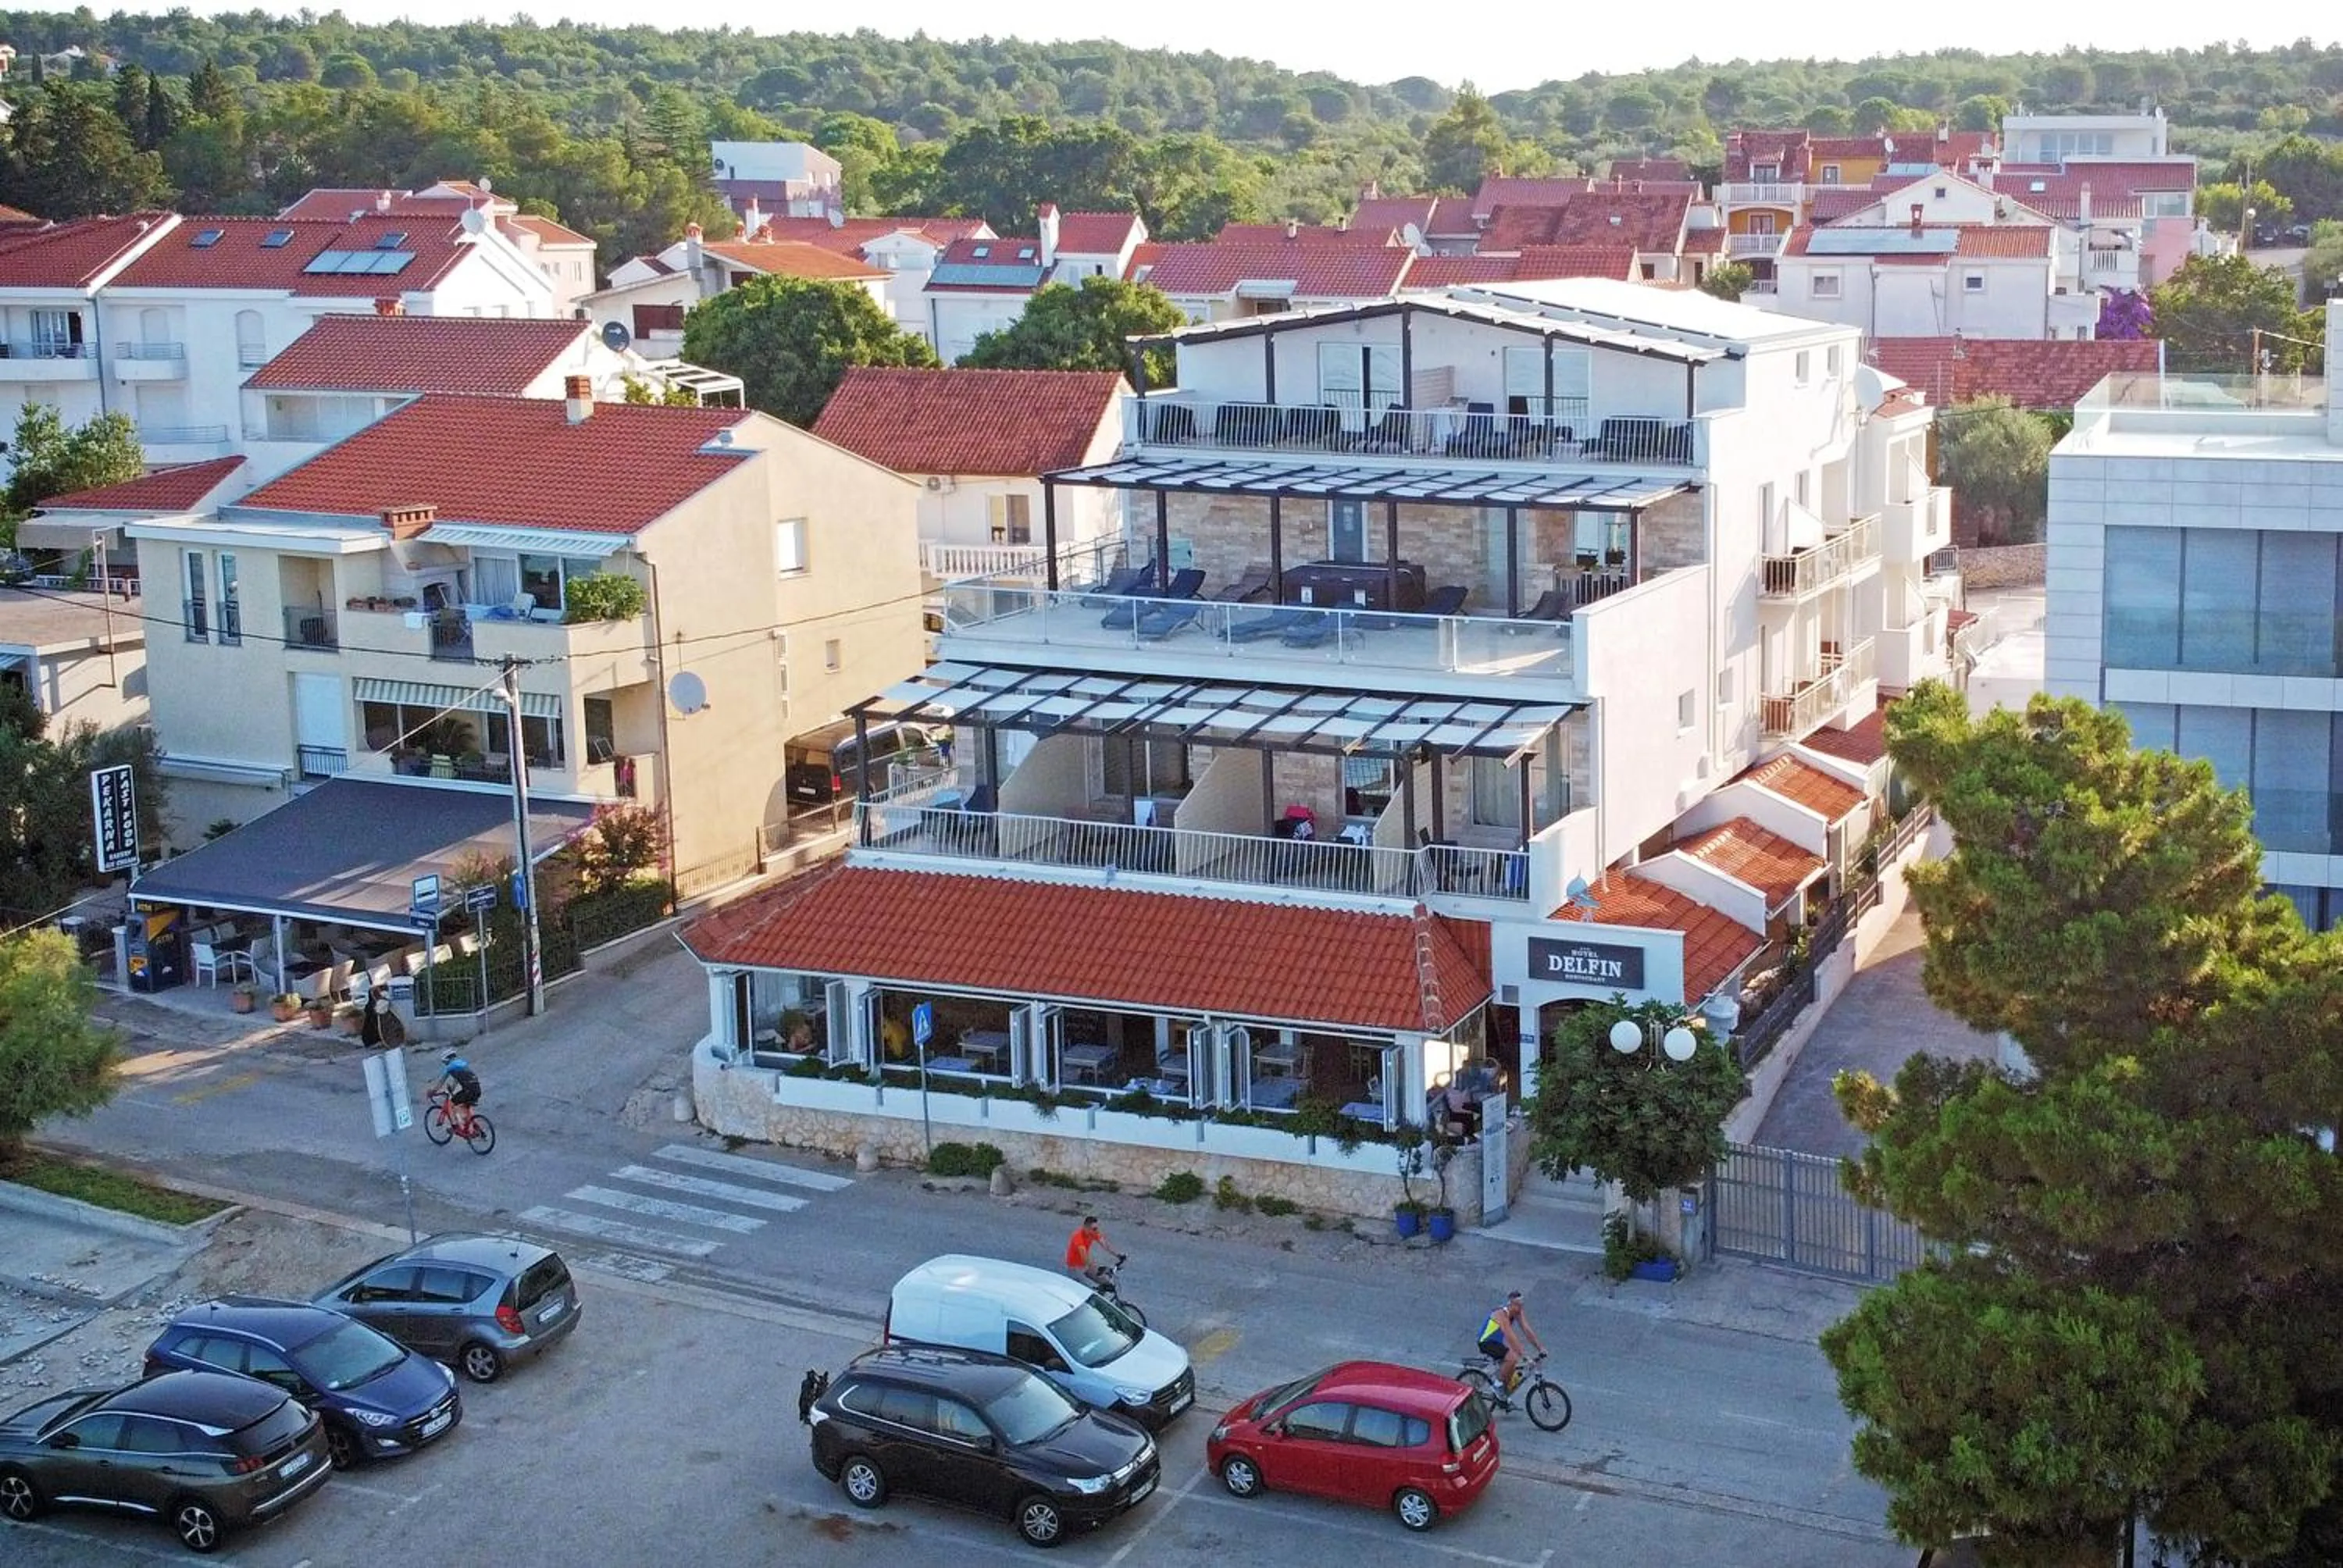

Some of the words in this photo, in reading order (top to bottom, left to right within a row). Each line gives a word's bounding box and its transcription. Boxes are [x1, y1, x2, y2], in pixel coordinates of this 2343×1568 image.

[119, 770, 131, 807] FAST
[101, 774, 116, 852] PEKARNA
[123, 810, 134, 847] FOOD
[1547, 953, 1622, 978] DELFIN
